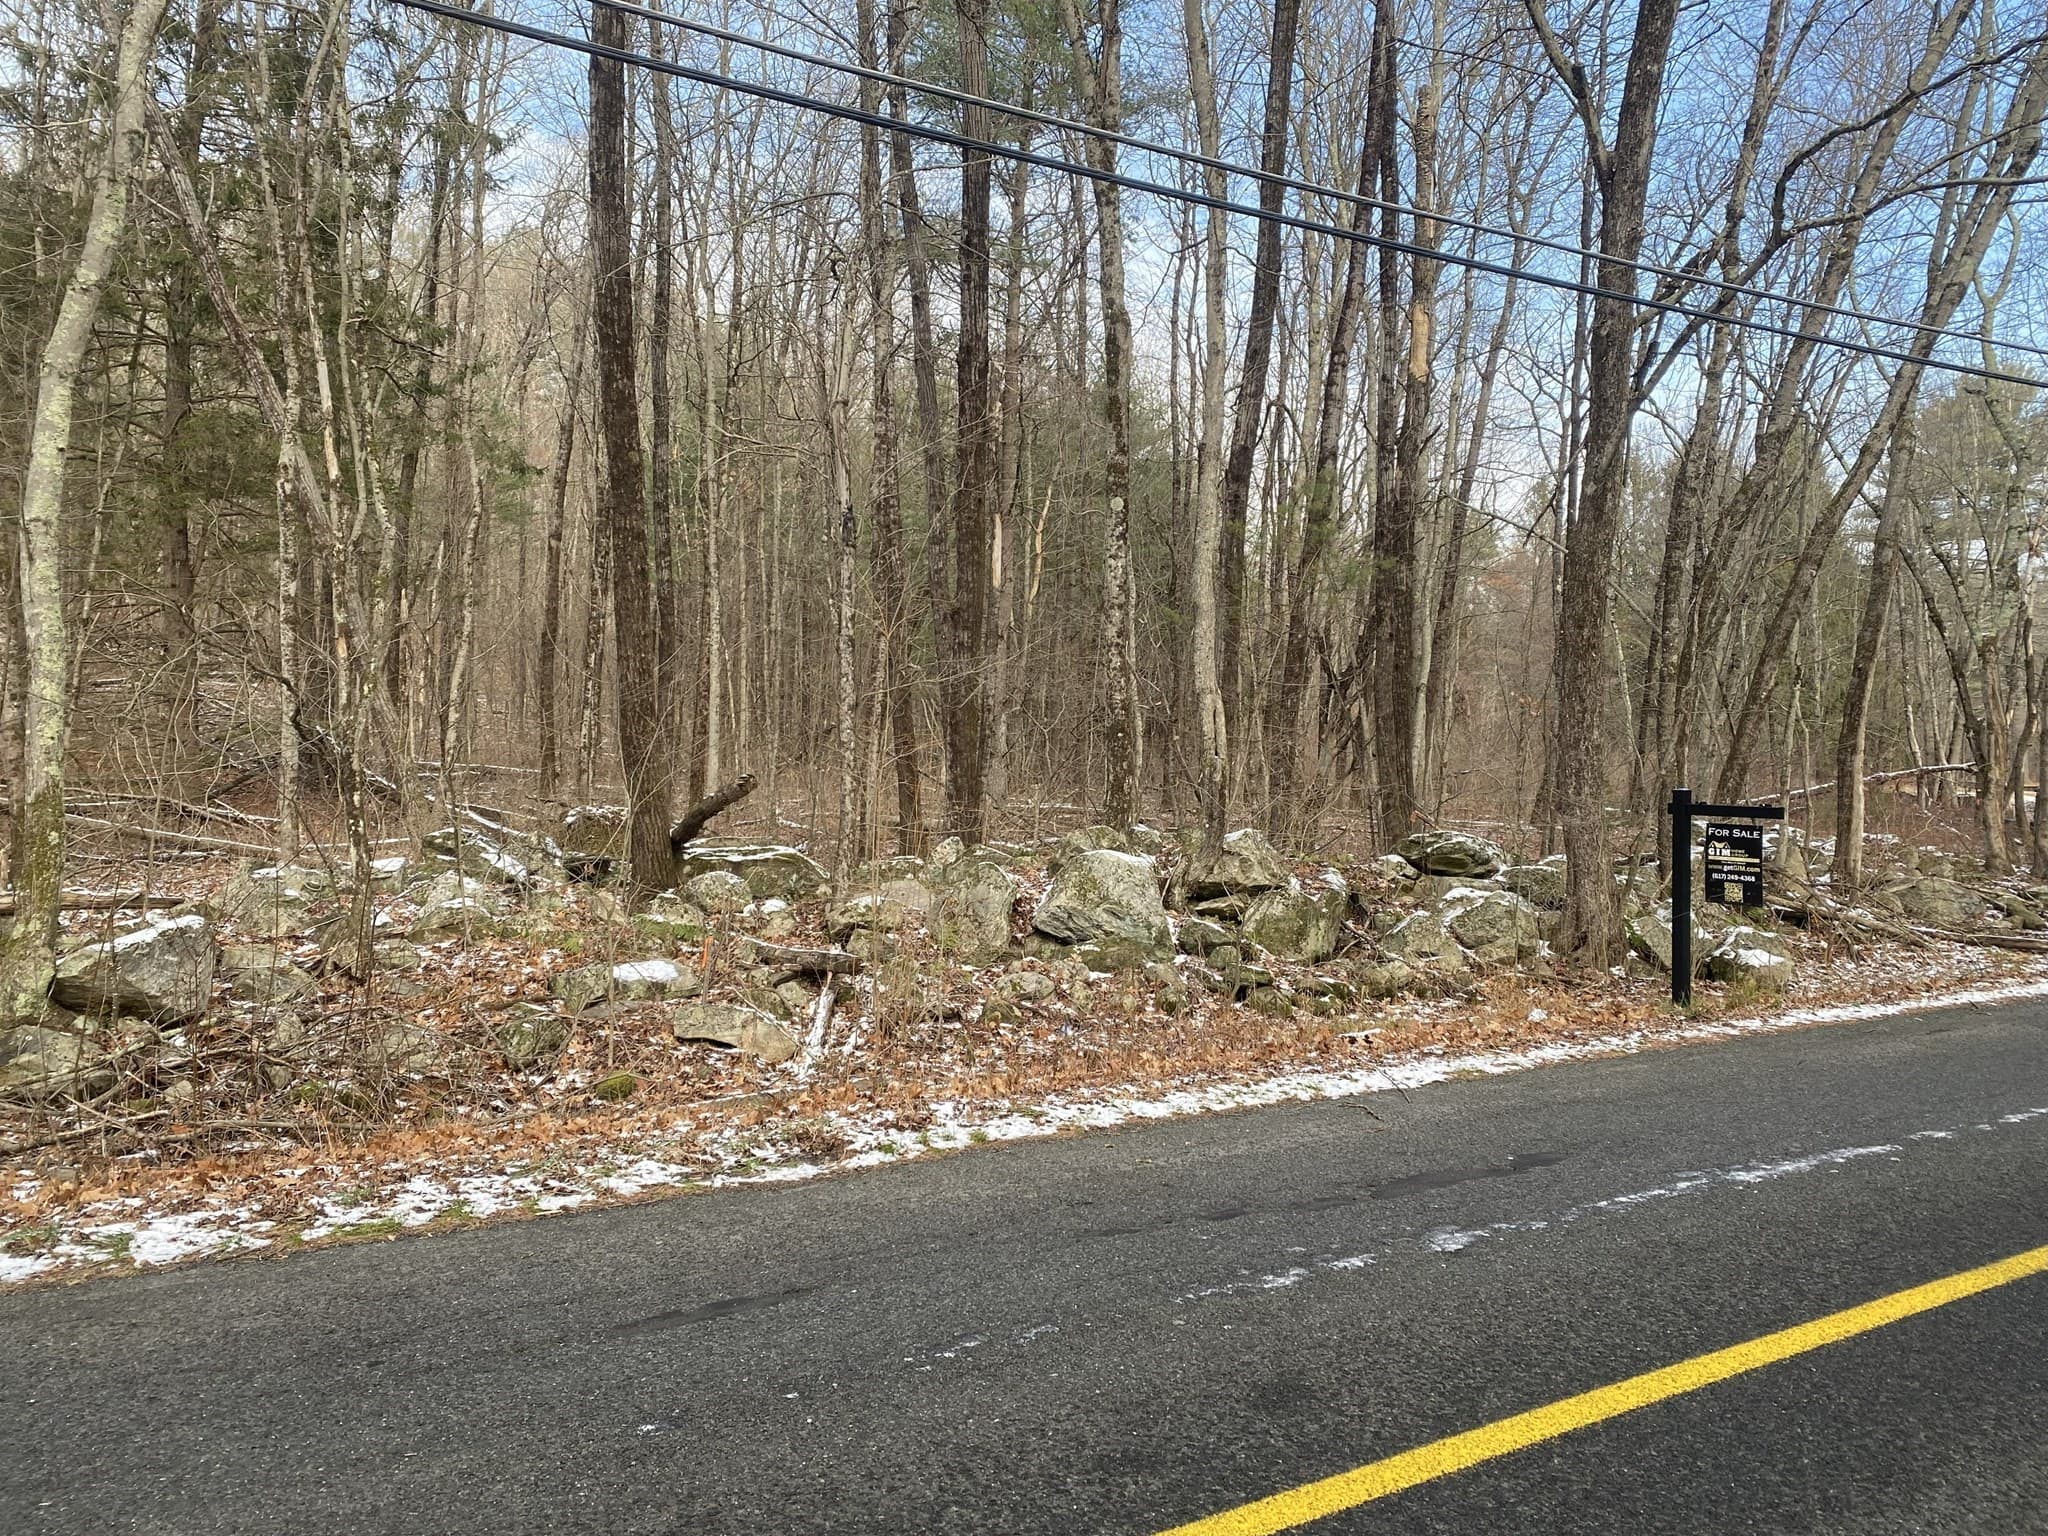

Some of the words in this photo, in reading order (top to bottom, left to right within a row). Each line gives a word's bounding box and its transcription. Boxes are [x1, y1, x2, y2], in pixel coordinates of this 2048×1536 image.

[1708, 827, 1730, 837] FOR
[1732, 829, 1761, 839] SALE
[1708, 847, 1731, 857] GIM
